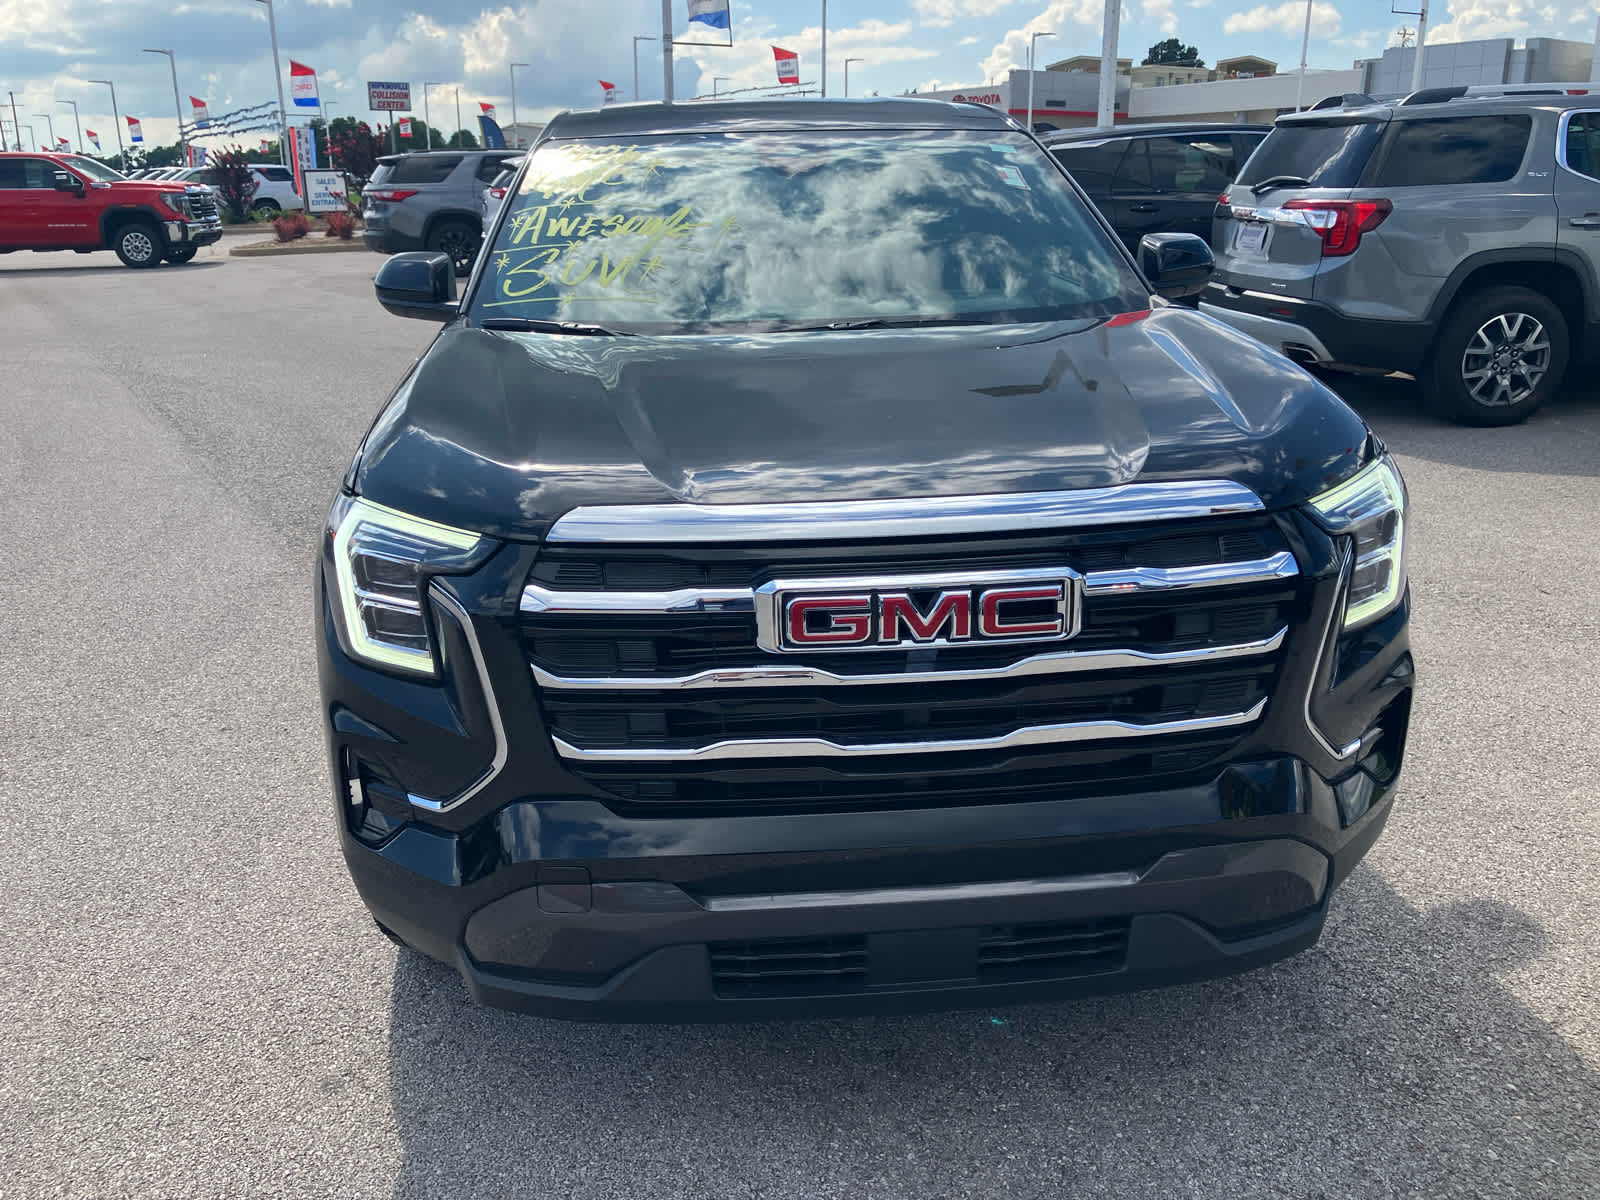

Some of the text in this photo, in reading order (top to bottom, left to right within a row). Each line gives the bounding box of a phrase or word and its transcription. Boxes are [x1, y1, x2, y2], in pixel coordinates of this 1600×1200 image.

[372, 90, 409, 99] COLLISION
[968, 94, 1001, 104] TOYOTA
[316, 177, 336, 185] SALES
[787, 585, 1062, 643] GMC
